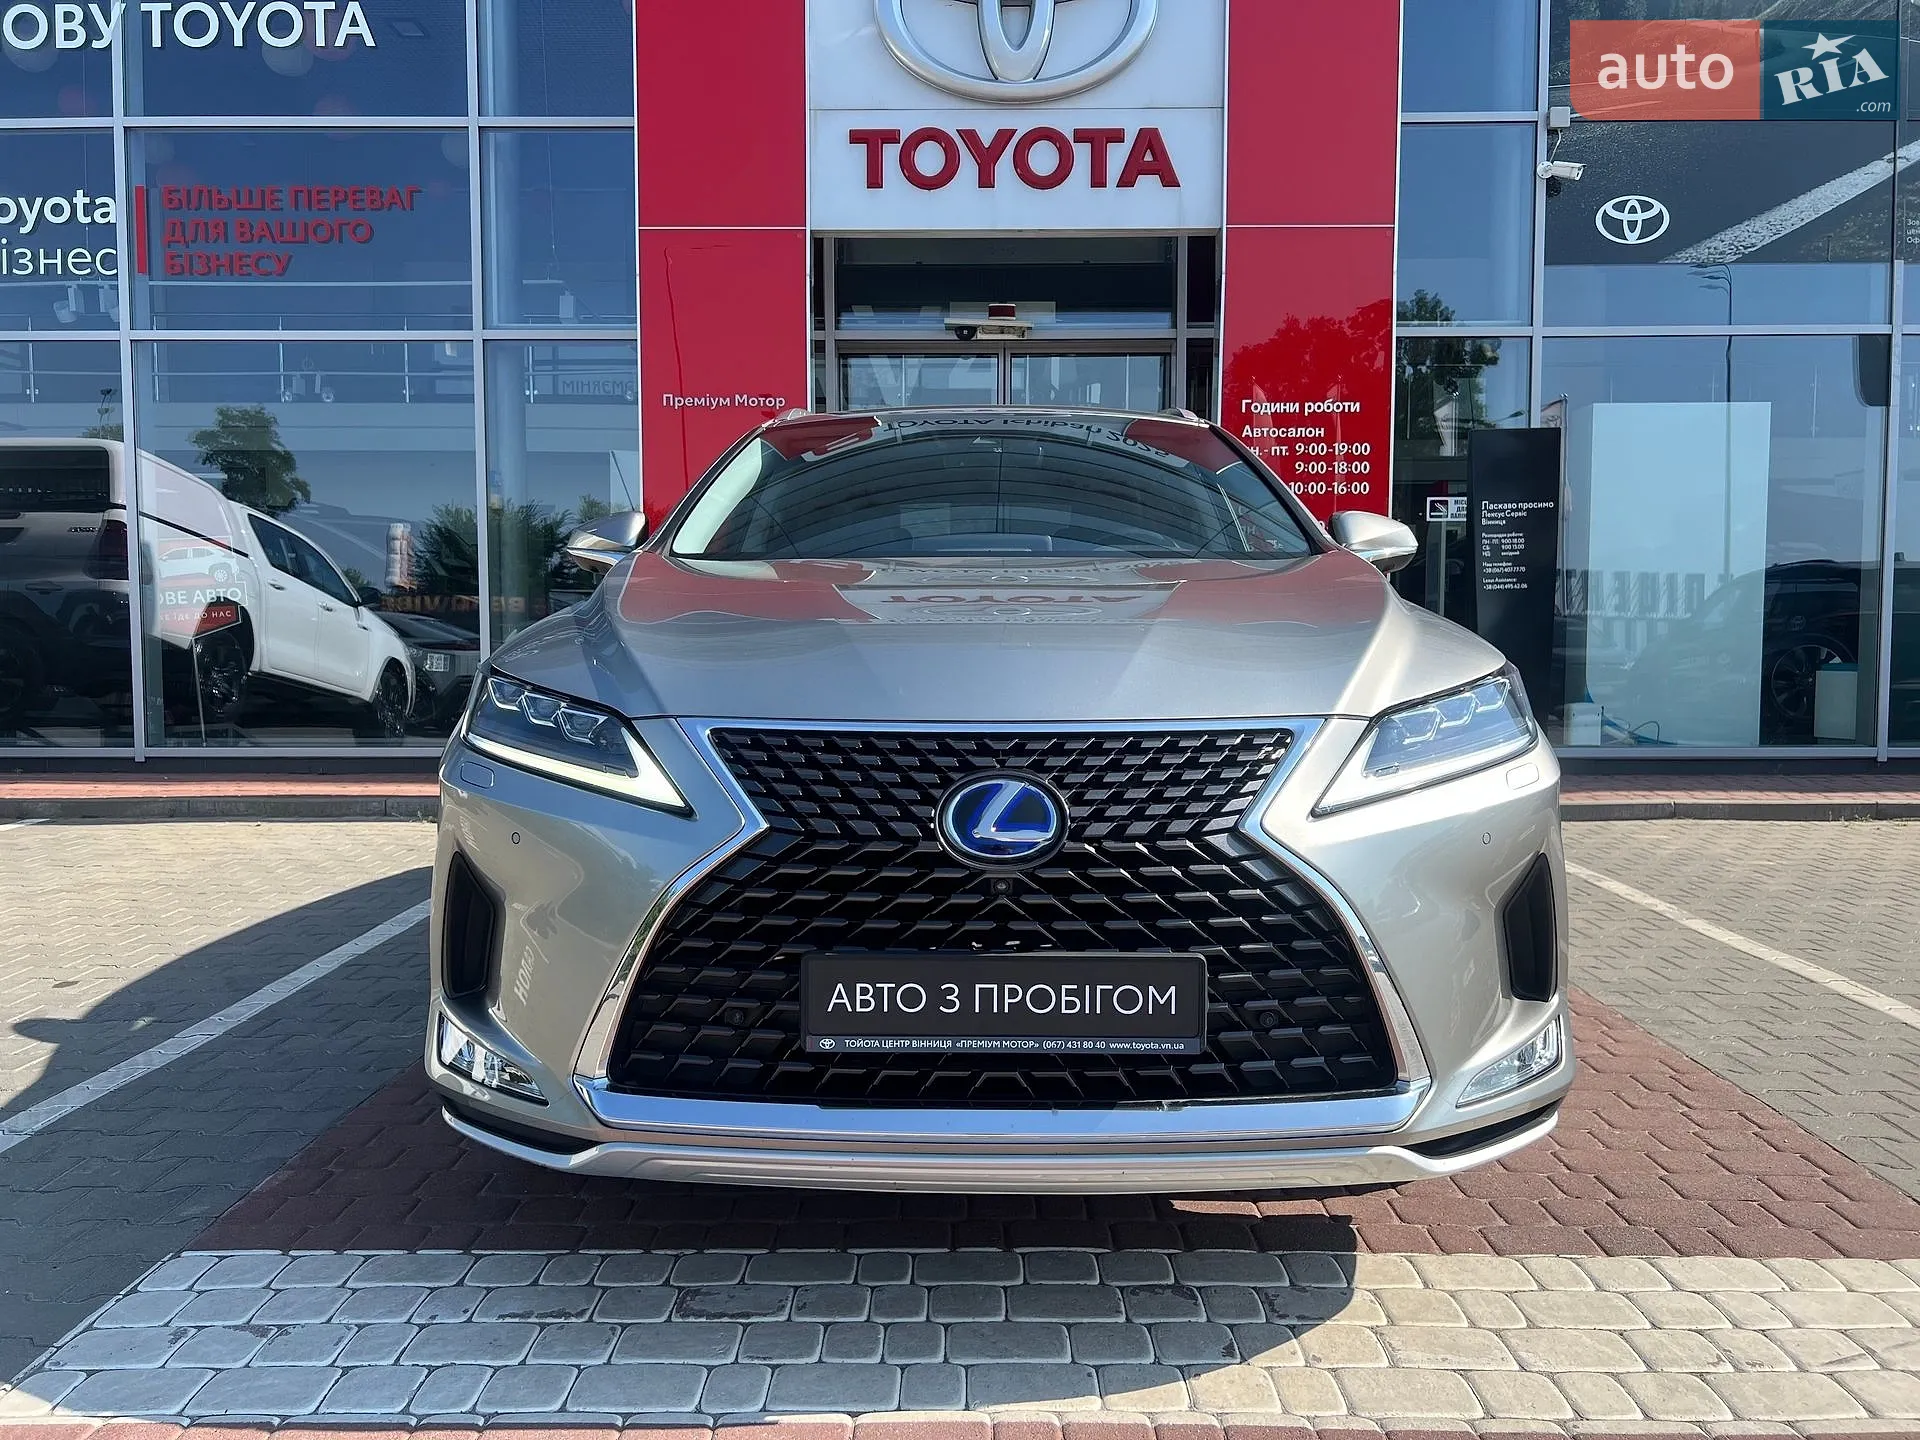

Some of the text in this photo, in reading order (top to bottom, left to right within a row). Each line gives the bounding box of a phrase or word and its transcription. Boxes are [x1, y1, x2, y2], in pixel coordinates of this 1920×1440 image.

[141, 1, 376, 48] TOYOTA
[849, 126, 1181, 190] TOYOTA
[162, 185, 421, 211] БІЛЬШЕ ПЕРЕВАГ
[163, 218, 374, 247] ДЛЯ ВАШОГО
[164, 251, 292, 276] БІЗНЕСУ
[662, 394, 785, 409] Преміум Мотор
[1241, 399, 1360, 416] Години роботи
[1241, 425, 1325, 438] Автосалон
[1295, 443, 1371, 456] 9:00-19:00
[1295, 461, 1370, 474] 9:00-18:00
[1518, 501, 1554, 510] просимо
[192, 587, 242, 604] АВТО
[211, 611, 232, 619] НАС
[827, 982, 1177, 1015] АВТО З ПРОБІГОМ
[845, 1038, 1184, 1051] ТОЙОТА ЦЕНТР ВІННИЦЯ «ПРЕМІУМ МОТОР» (067) 431 80 40 www.toyota.vn.ua
